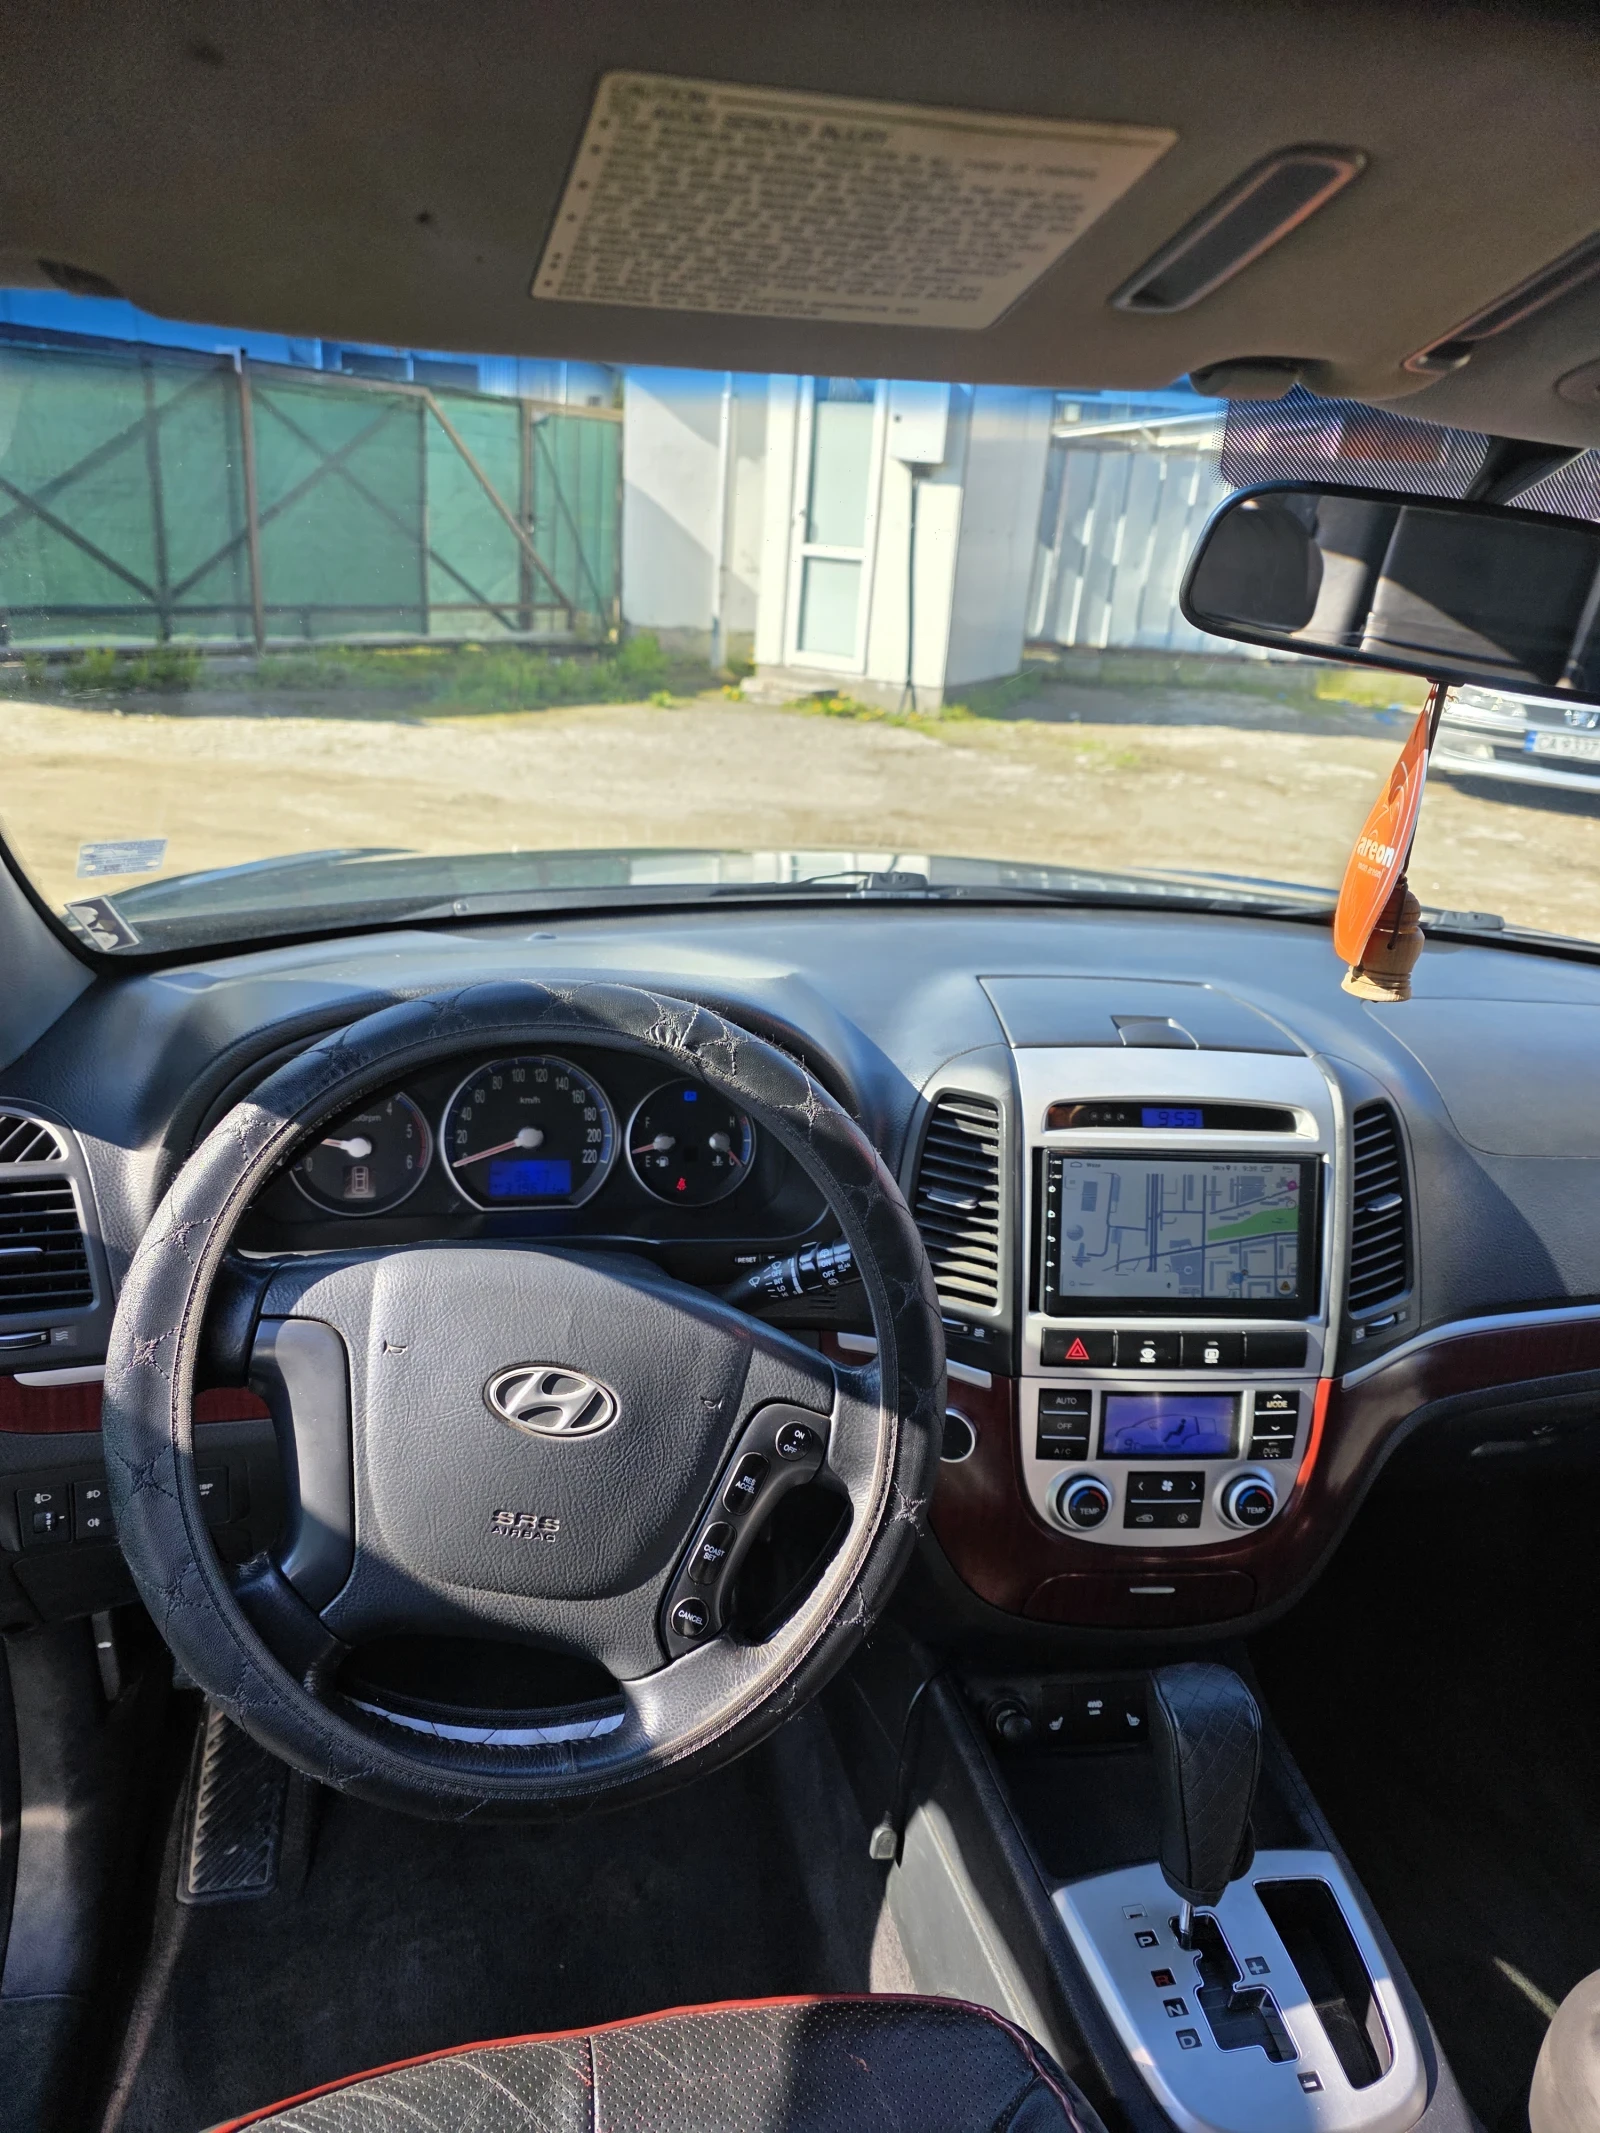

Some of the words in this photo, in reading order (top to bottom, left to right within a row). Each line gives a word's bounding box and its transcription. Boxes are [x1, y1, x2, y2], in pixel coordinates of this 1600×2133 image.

[1357, 836, 1395, 868] areon
[512, 1068, 525, 1082] 100
[534, 1068, 548, 1082] 120
[492, 1076, 502, 1090] 80
[555, 1076, 569, 1091] 140
[474, 1089, 485, 1104] 60
[519, 1096, 541, 1104] km/h
[571, 1090, 585, 1104] 160
[386, 1102, 393, 1116] 4
[461, 1107, 472, 1121] 40
[583, 1107, 597, 1121] 180
[729, 1116, 736, 1128] H
[406, 1124, 413, 1139] 5
[456, 1130, 468, 1144] 20
[587, 1129, 602, 1143] 200
[406, 1155, 413, 1170] 6
[582, 1149, 597, 1164] 220
[645, 1155, 651, 1168] E
[306, 1156, 313, 1173] 0
[737, 1256, 757, 1264] RESET
[771, 1269, 783, 1278] OFF
[822, 1270, 836, 1279] OFF
[773, 1277, 784, 1286] INT
[776, 1285, 786, 1293] LO
[1055, 1397, 1078, 1405] AUTO
[1266, 1400, 1288, 1409] MODE
[1056, 1422, 1073, 1430] OFF
[794, 1429, 805, 1440] ON
[783, 1444, 797, 1453] OFF
[735, 1480, 755, 1494] ACCEL
[743, 1475, 757, 1486] RES
[1079, 1506, 1100, 1515] TEMP
[1246, 1506, 1266, 1514] TEMP
[491, 1509, 560, 1532] SRS
[491, 1525, 556, 1543] AIRBAG
[703, 1544, 725, 1557] COAST
[703, 1552, 717, 1562] SET
[678, 1609, 703, 1626] CANCEL
[1166, 2004, 1184, 2018] N
[1180, 2034, 1196, 2048] D
